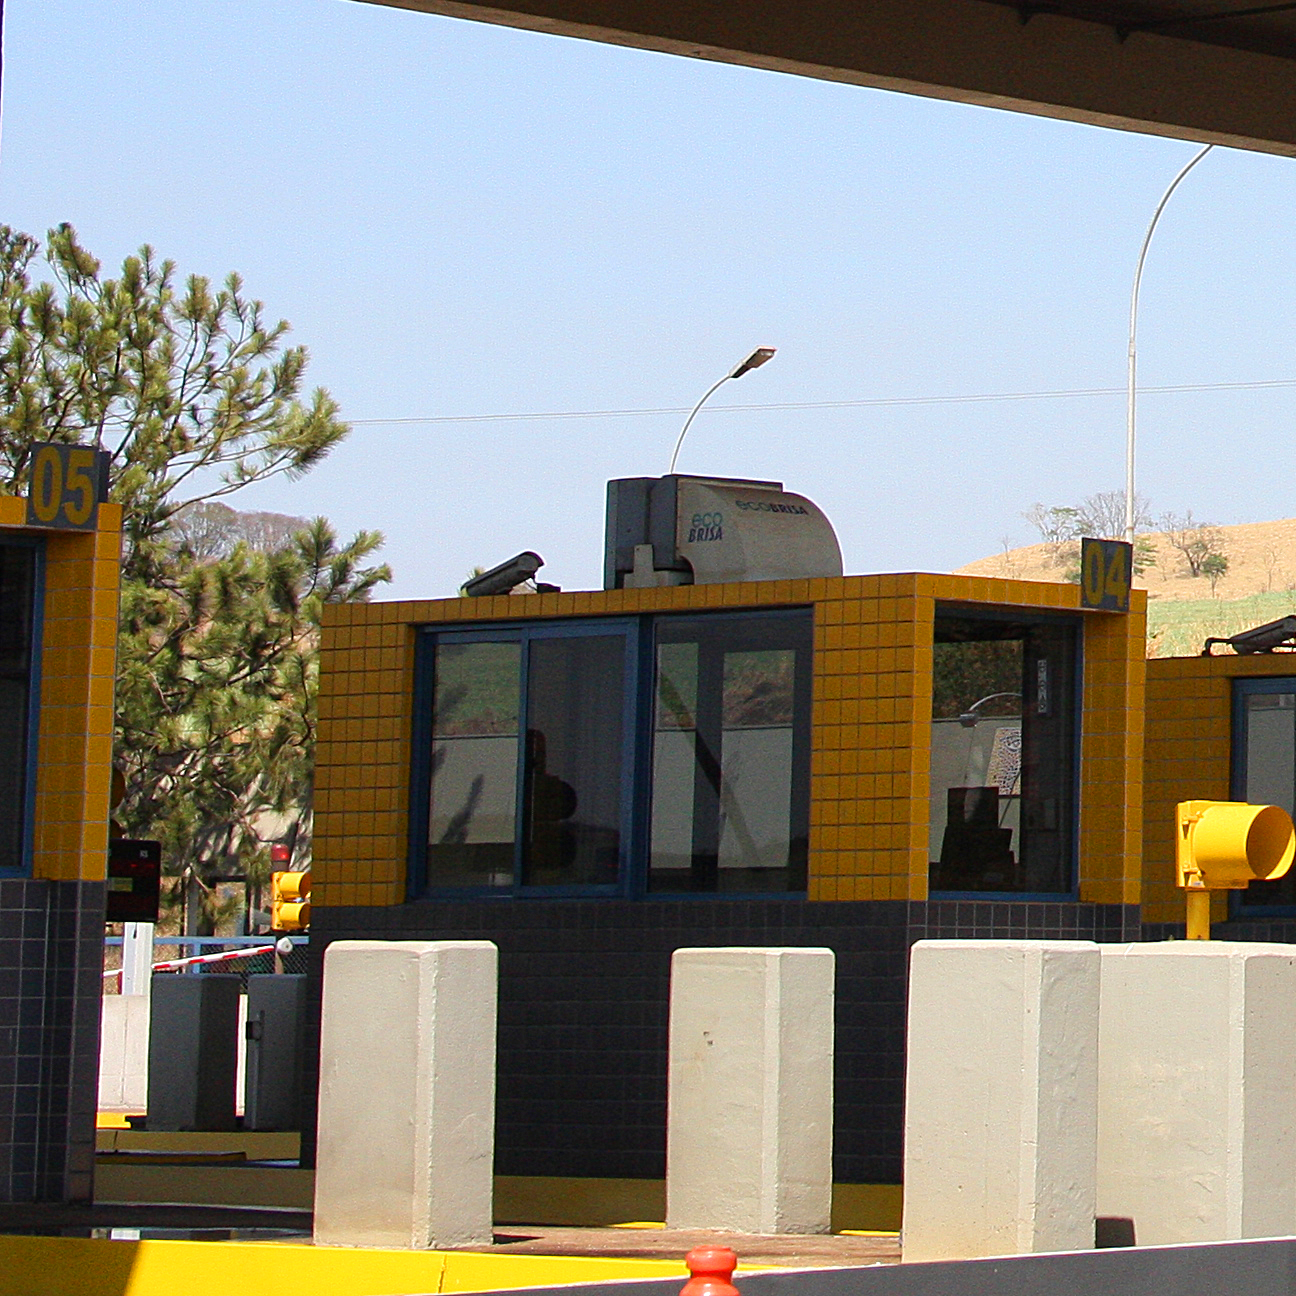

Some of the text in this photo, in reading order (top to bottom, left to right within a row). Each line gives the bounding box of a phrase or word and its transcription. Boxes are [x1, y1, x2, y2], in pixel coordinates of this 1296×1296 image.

[33, 446, 95, 525] 05
[688, 526, 723, 542] BRISA
[692, 512, 723, 527] eco
[1085, 541, 1127, 608] 04
